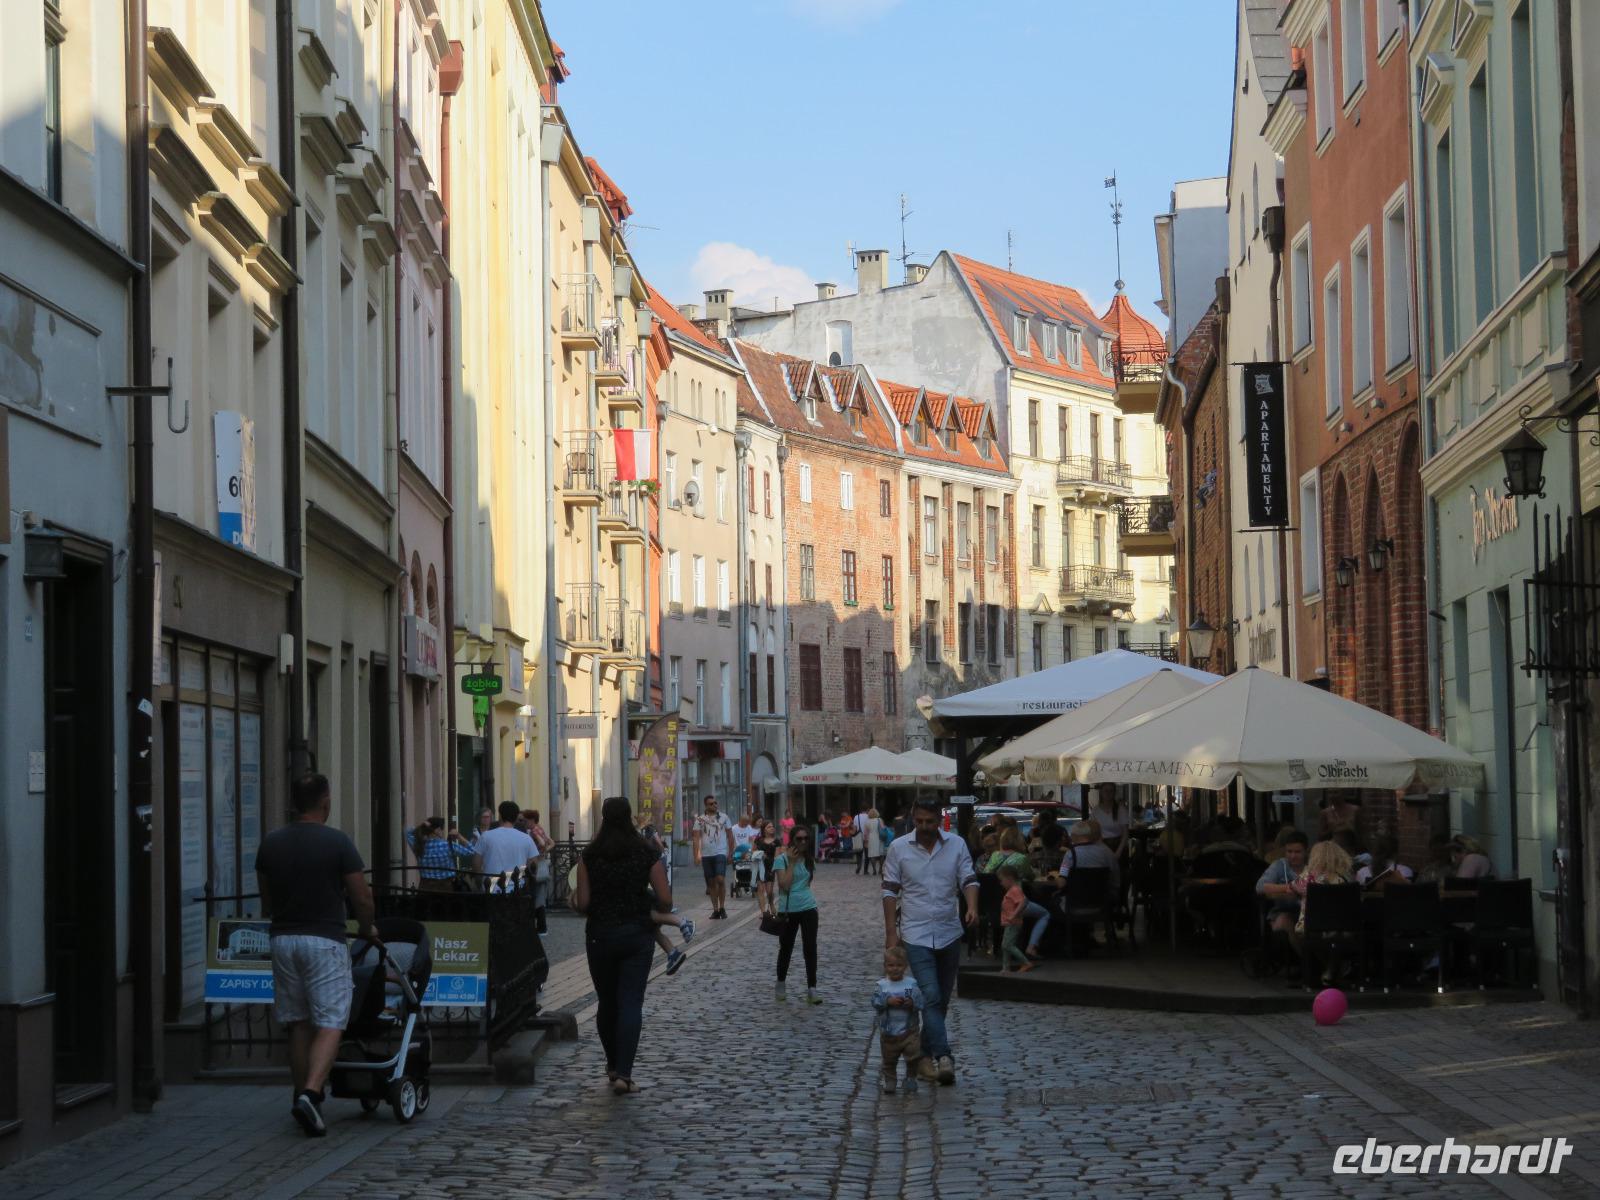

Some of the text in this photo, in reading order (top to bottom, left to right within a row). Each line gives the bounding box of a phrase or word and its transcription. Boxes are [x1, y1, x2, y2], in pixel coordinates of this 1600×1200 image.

[1259, 400, 1273, 516] APARTAMENTY
[1090, 758, 1217, 778] APARTAMENTY
[1318, 764, 1369, 778] Olbracht
[663, 721, 678, 833] STAR WARS
[434, 937, 468, 949] Nasz
[434, 949, 480, 962] Lekarz
[219, 978, 259, 989] ZAPISY
